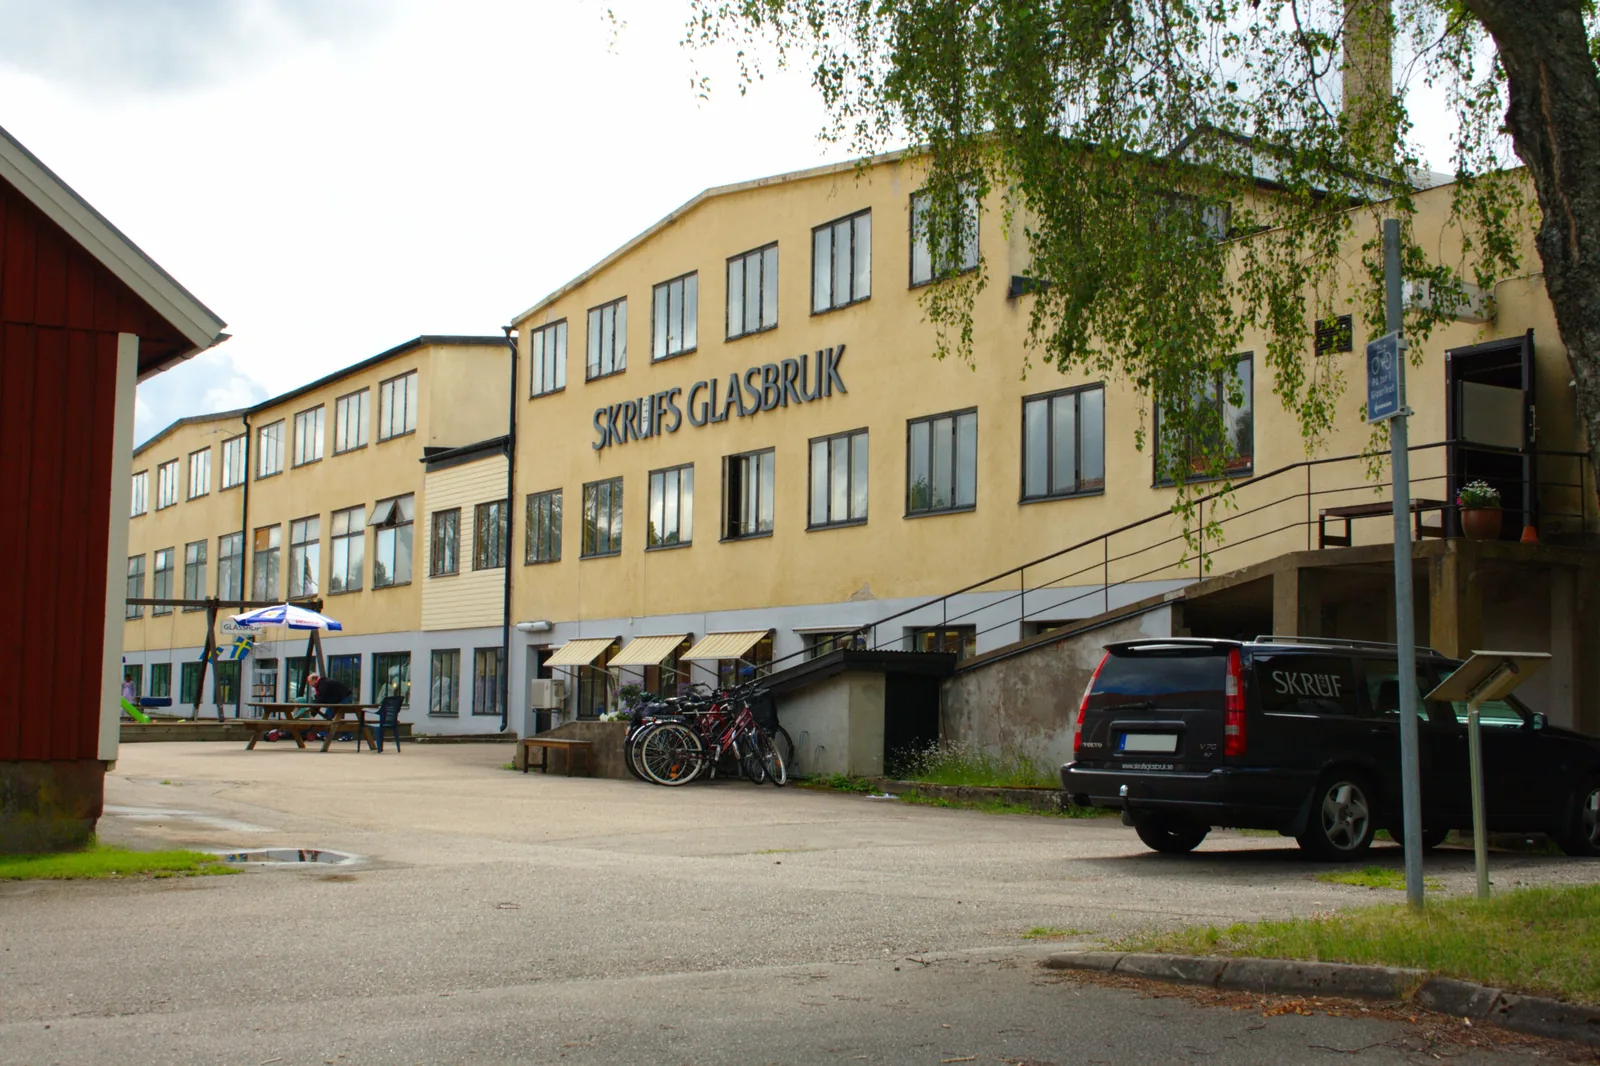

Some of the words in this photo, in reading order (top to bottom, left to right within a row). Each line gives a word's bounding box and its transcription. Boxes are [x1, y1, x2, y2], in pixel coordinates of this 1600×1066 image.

[592, 387, 682, 450] SKRUFS
[687, 344, 848, 427] GLASBRUK
[1272, 670, 1342, 697] SKRUF
